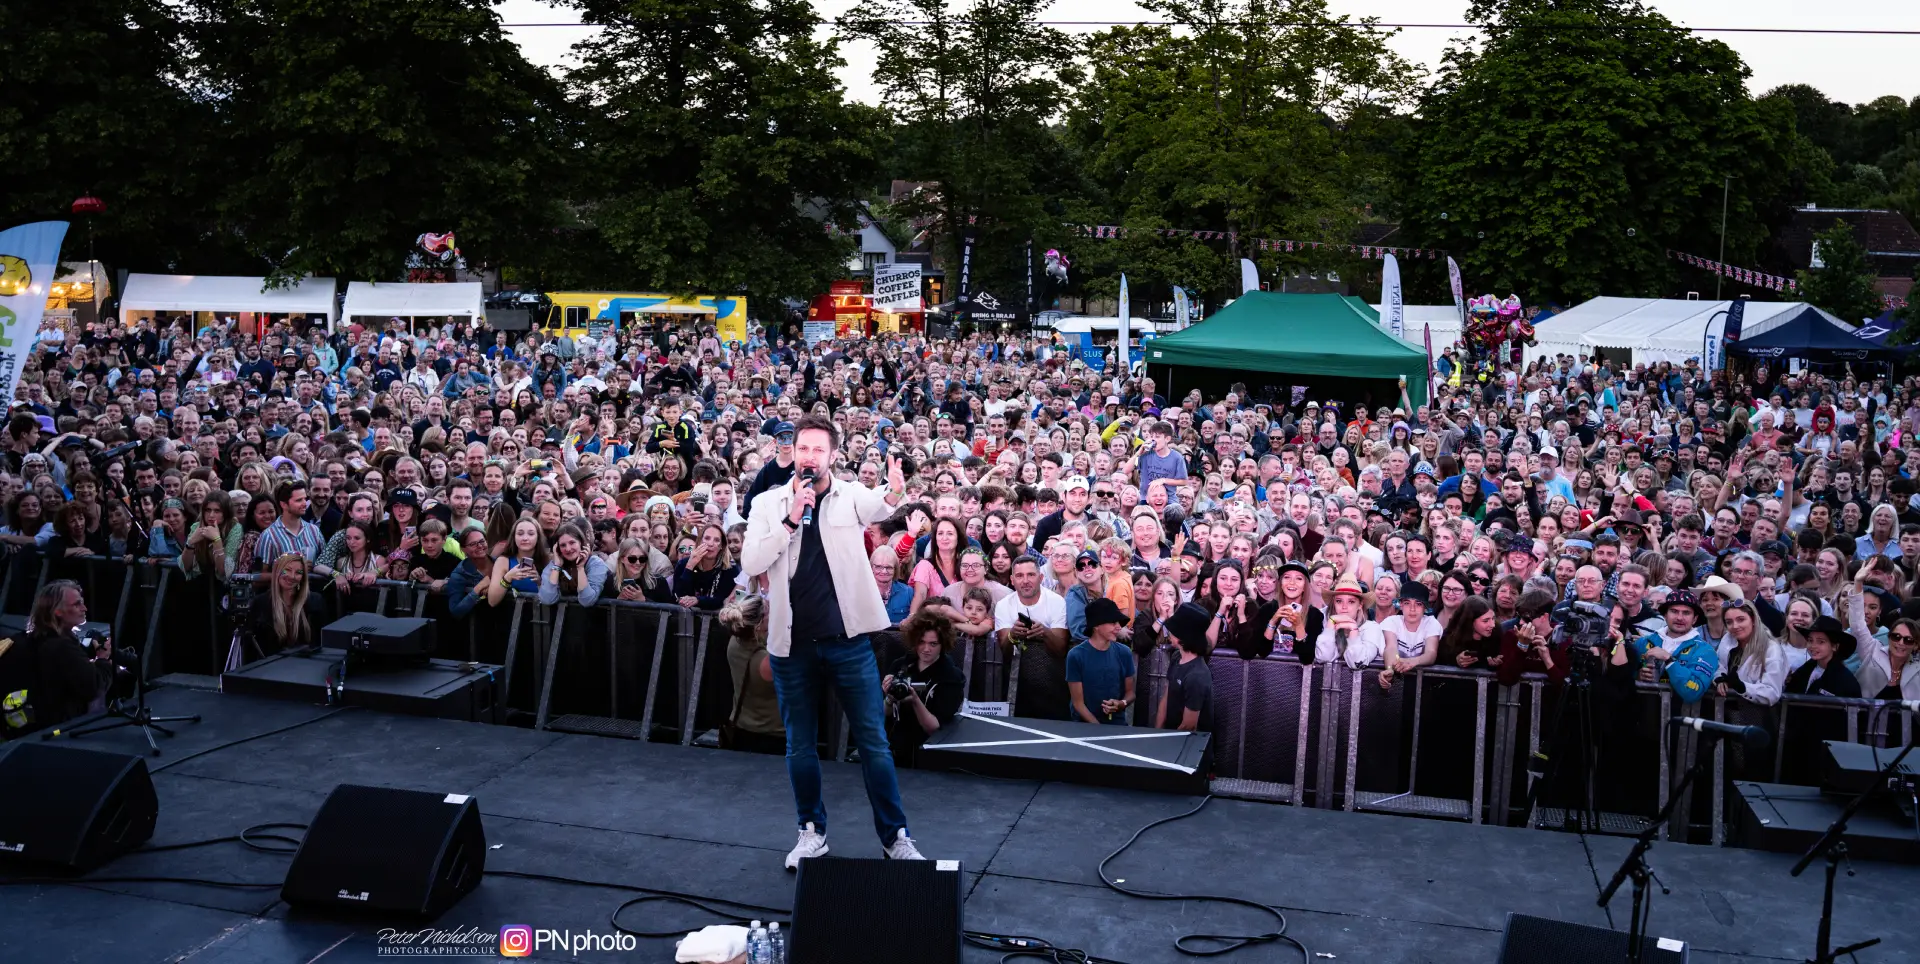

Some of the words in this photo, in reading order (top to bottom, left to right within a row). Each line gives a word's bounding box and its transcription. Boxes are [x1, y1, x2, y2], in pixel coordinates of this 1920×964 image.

[961, 245, 971, 293] BRAAI
[875, 270, 920, 285] CHURROS
[878, 281, 915, 294] COFFEE
[875, 289, 920, 305] WAFFLES
[1083, 350, 1103, 358] SLUS
